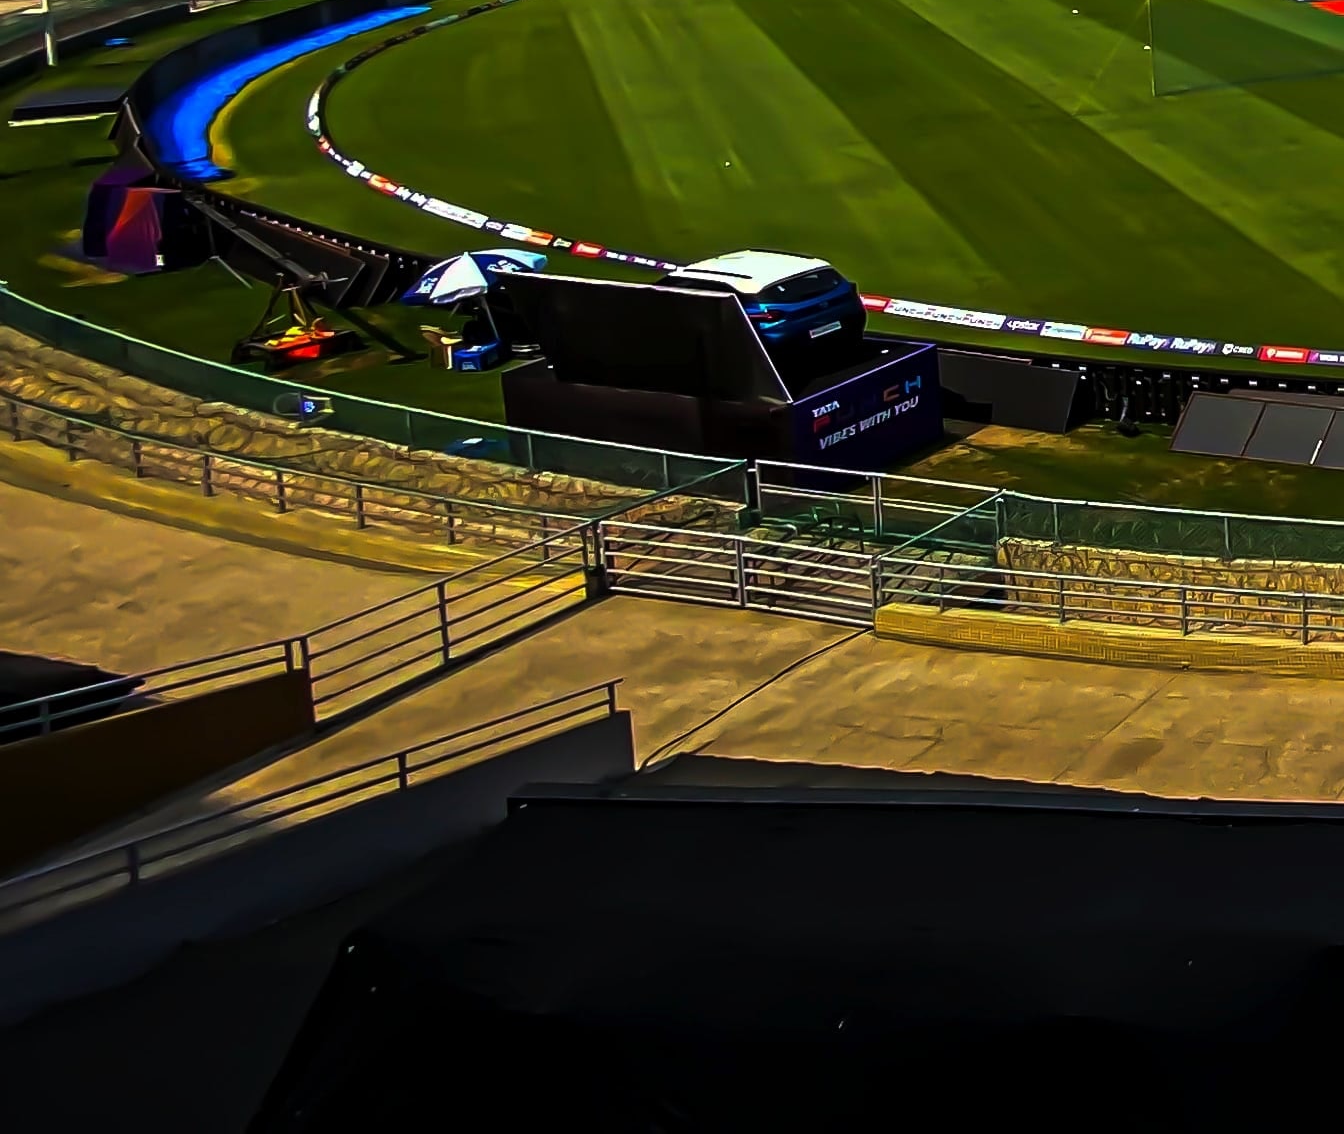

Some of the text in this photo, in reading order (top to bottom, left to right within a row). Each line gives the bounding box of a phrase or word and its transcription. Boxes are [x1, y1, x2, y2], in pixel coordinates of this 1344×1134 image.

[812, 400, 840, 418] TATA
[819, 395, 919, 450] VIBES WITH YOU
